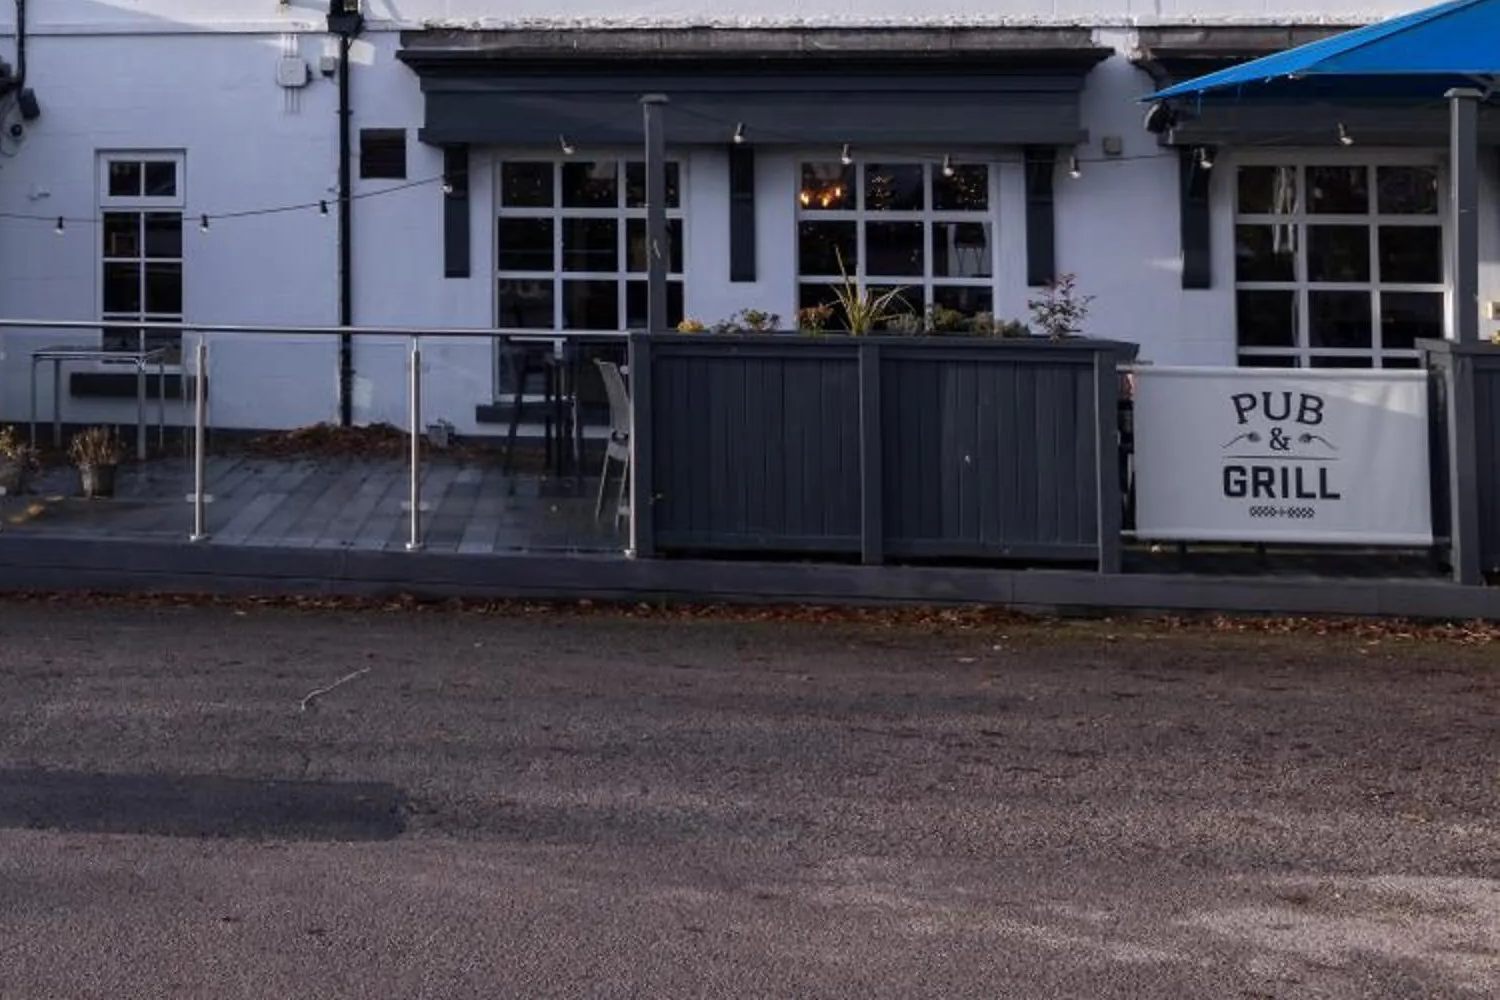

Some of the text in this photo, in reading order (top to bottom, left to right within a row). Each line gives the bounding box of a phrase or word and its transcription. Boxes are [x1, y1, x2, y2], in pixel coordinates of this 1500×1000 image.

[1231, 391, 1325, 425] PUB
[1269, 427, 1291, 451] &
[1223, 465, 1341, 500] GRILL
